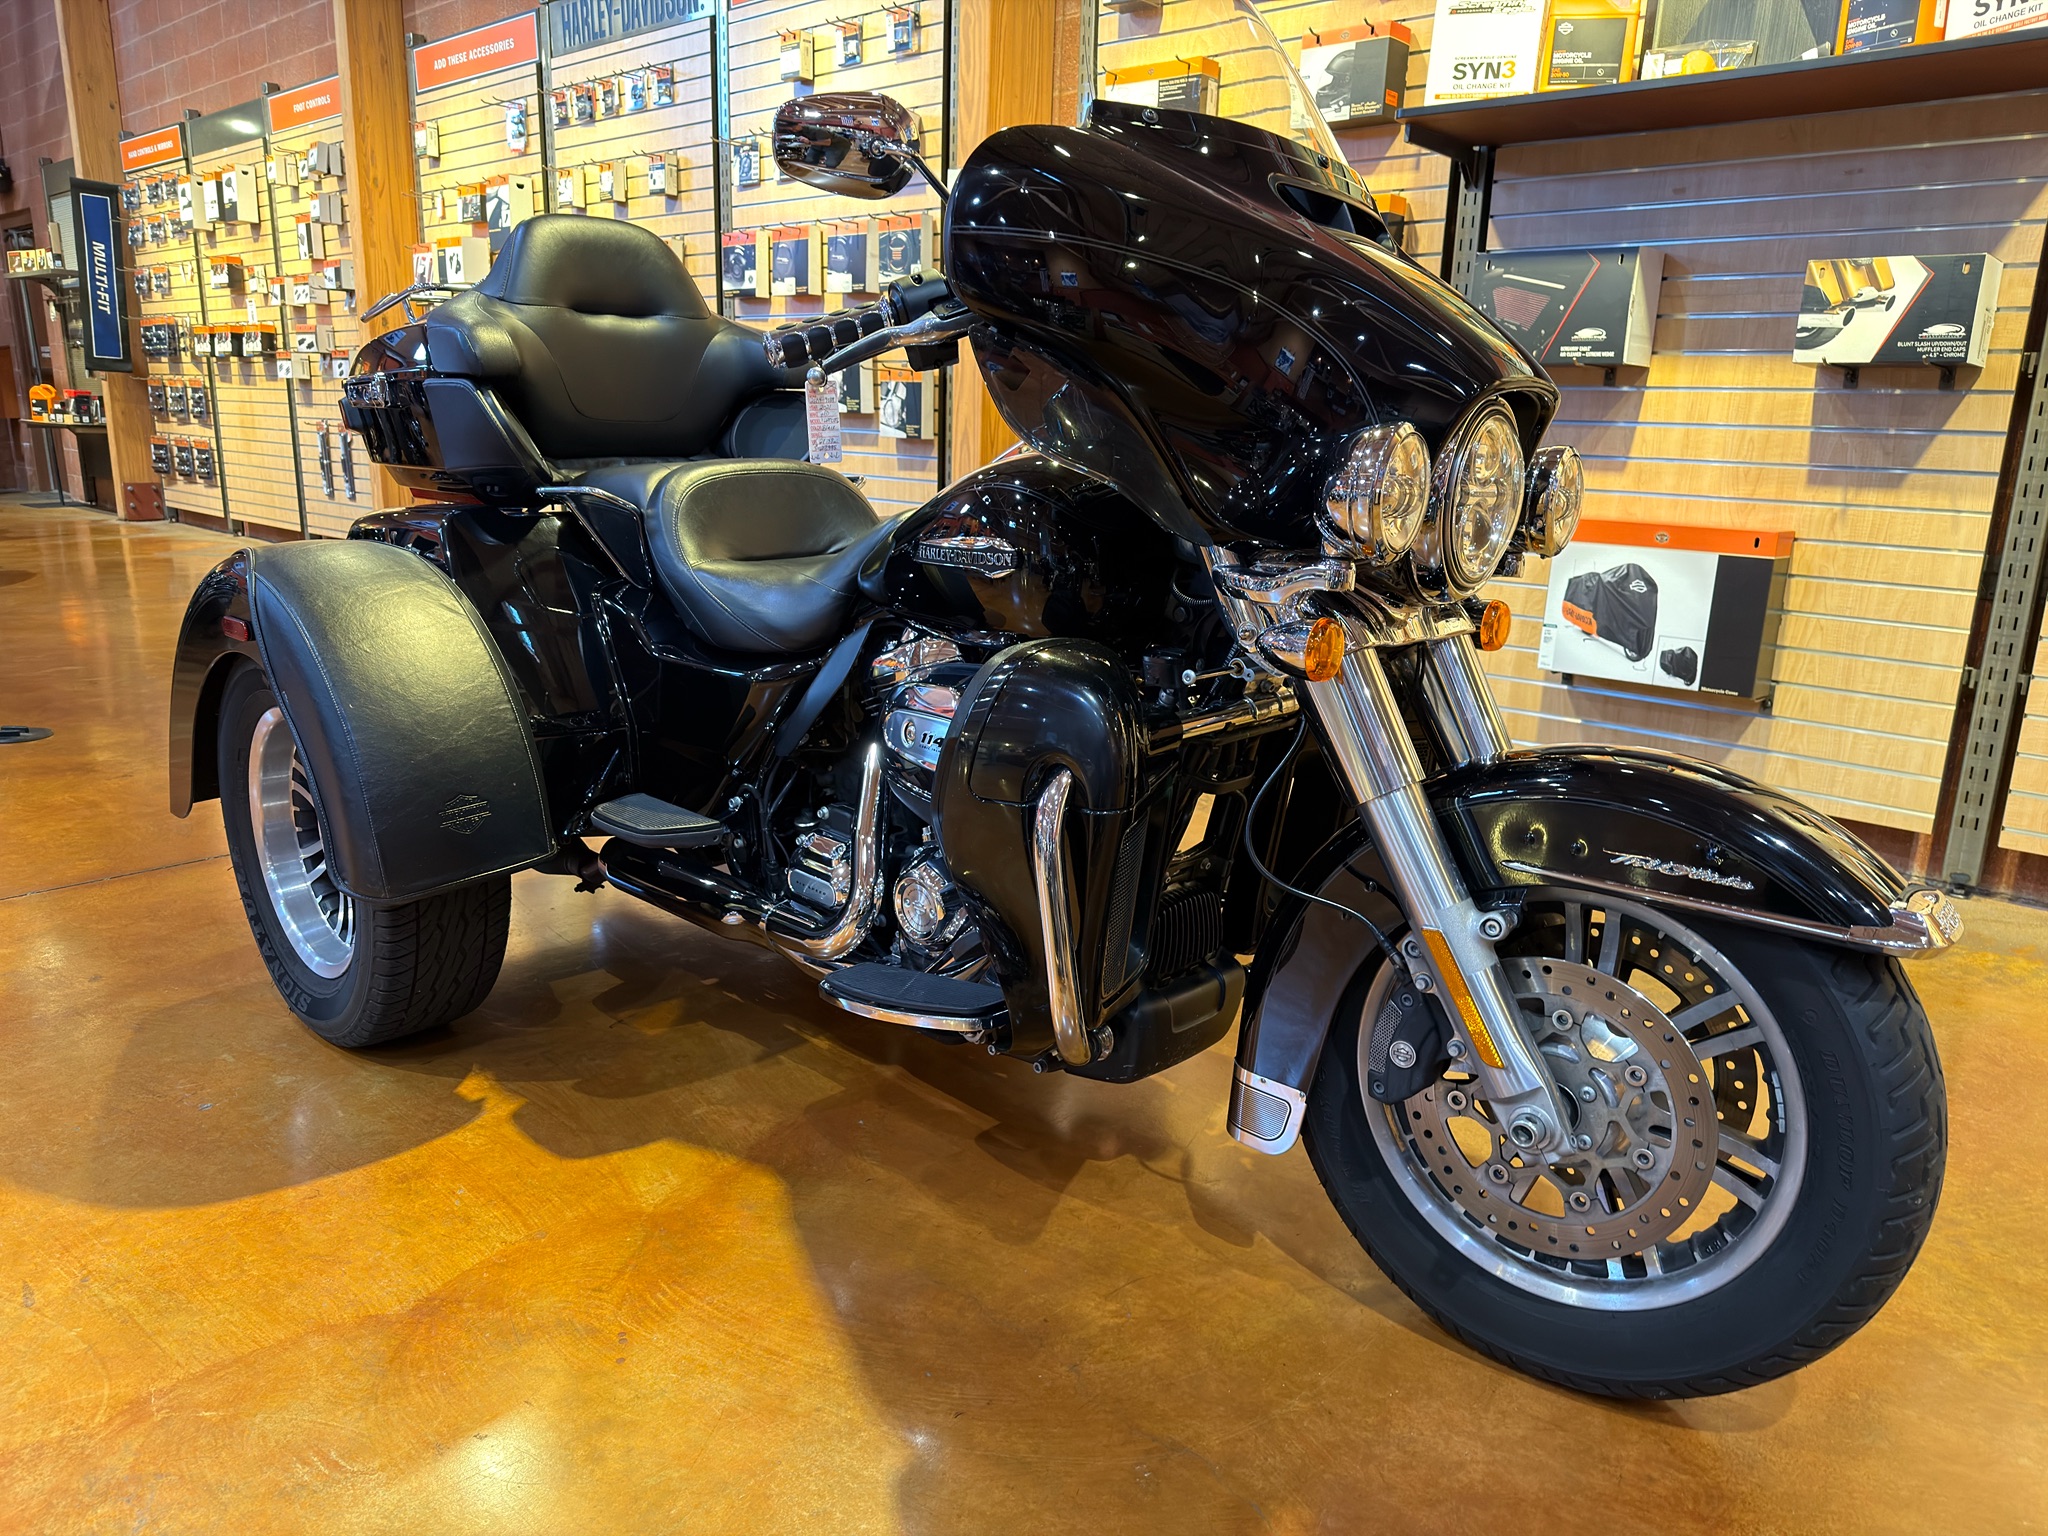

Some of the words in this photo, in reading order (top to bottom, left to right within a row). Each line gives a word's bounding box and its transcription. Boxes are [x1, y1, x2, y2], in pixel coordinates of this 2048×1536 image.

[561, 0, 699, 48] HARLEY-DAVI
[1848, 14, 1886, 28] MOTORCYCLE
[1974, 20, 1986, 29] OIL
[1989, 8, 2026, 24] CHANGE
[2028, 3, 2043, 13] KIT
[1847, 26, 1867, 35] ENGINE
[434, 58, 446, 70] ADD
[448, 52, 467, 66] THESE
[469, 38, 514, 60] ACCESSORIES
[1452, 61, 1516, 80] SYN3
[293, 102, 305, 113] FOOT
[306, 94, 330, 110] CONTROLS
[138, 144, 153, 156] CONTROLS
[157, 140, 174, 150] MIRRORS
[92, 241, 110, 315] MULTI-FIT
[920, 545, 1012, 566] HARLEY-DAVIDSON
[1701, 686, 1724, 694] Motorcycle
[921, 733, 945, 747] 114
[1821, 1050, 1855, 1192] DUNLOP
